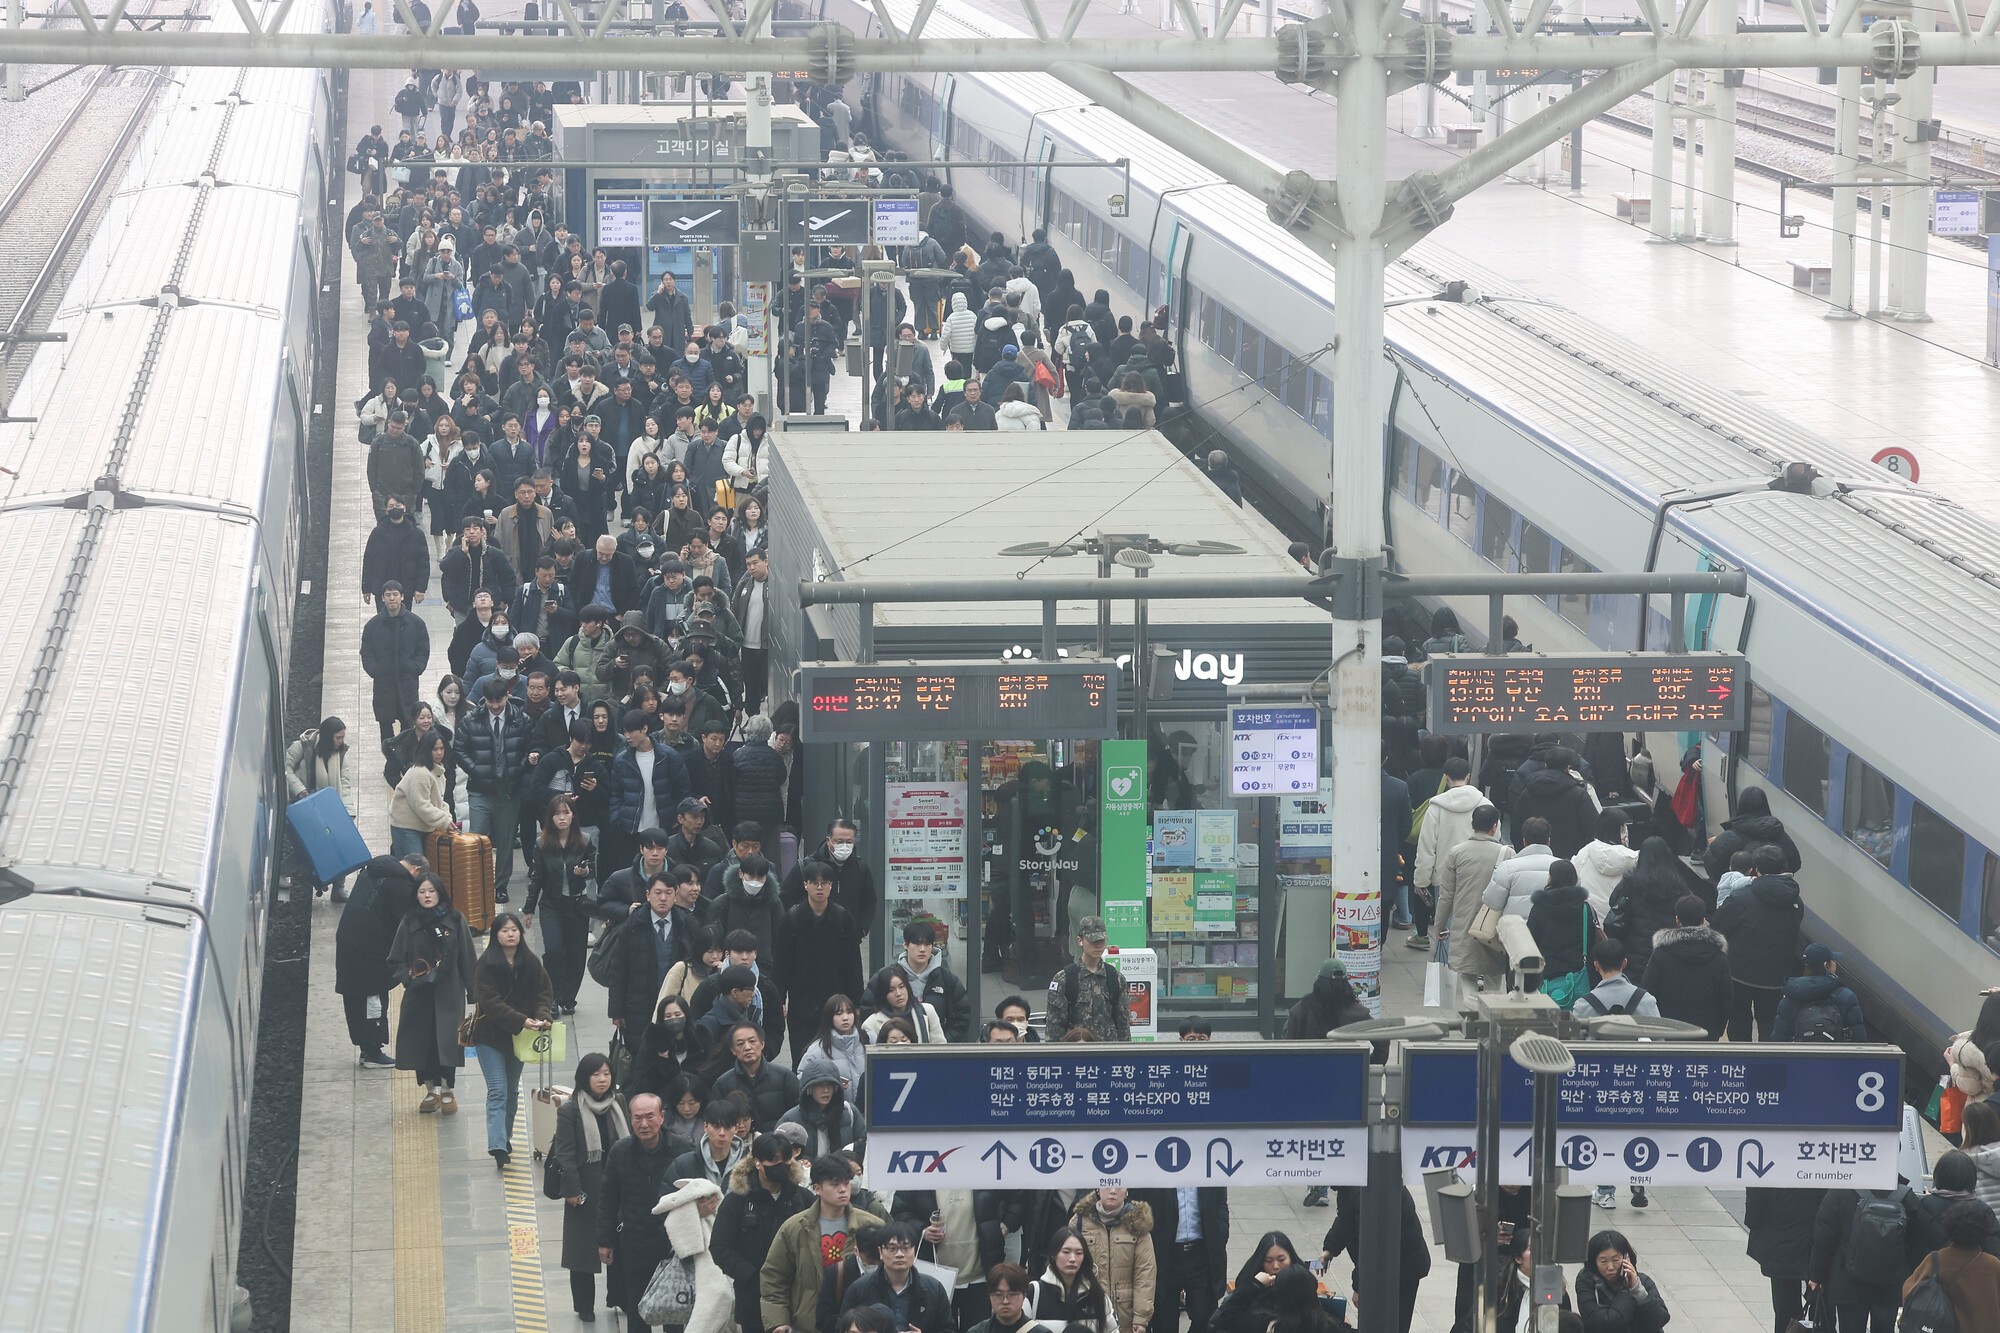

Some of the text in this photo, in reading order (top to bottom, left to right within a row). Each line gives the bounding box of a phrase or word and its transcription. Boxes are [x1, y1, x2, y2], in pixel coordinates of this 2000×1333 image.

[656, 140, 729, 156] 고객대기실
[813, 695, 848, 712] 이번
[1237, 713, 1272, 724] 호차번호
[1234, 733, 1253, 741] KTX
[1261, 752, 1273, 760] 호차
[1301, 752, 1313, 760] 호차
[1278, 763, 1296, 771] 무궁화
[1261, 782, 1273, 790] 호차
[1301, 781, 1314, 789] 호차
[1105, 803, 1144, 811] 자동심장충격기
[1019, 860, 1079, 872] StoryWay
[1336, 907, 1360, 921] 전기
[1129, 982, 1146, 992] ED
[990, 1064, 1208, 1081] 대전 동대구 부산 포항 진주 마산
[1613, 1064, 1746, 1078] 부산 포항 진주 마산
[990, 1080, 1207, 1090] Daejeon Dongdaegu Busan Pohang Jinju Masan
[1562, 1079, 1745, 1089] Dongdaegu Busan Pohang Jinju Masan
[889, 1072, 918, 1112] 7
[1560, 1090, 1780, 1105] 익산 광주송정 목포 여수EXPO 방면
[1854, 1071, 1885, 1113] 8
[990, 1091, 1210, 1107] 익산 광주송정 목포 여수EXPO 방면
[990, 1107, 1163, 1118] Iksan Gwangju songjeong Mokpo Yeosu Expo
[1565, 1105, 1746, 1115] Iksan Gwangju songjeong Mokpo Yeosu Expo
[1266, 1139, 1345, 1160] 호차번호
[1563, 1141, 1596, 1165] 18
[1797, 1141, 1877, 1164] 호차번호
[887, 1145, 962, 1173] KTX
[1031, 1143, 1063, 1168] 18
[1420, 1145, 1477, 1169] KTX
[1266, 1167, 1322, 1178] Car number
[1796, 1170, 1853, 1181] Car number
[1099, 1178, 1122, 1187] 현위치
[1629, 1176, 1652, 1185] 현위치
